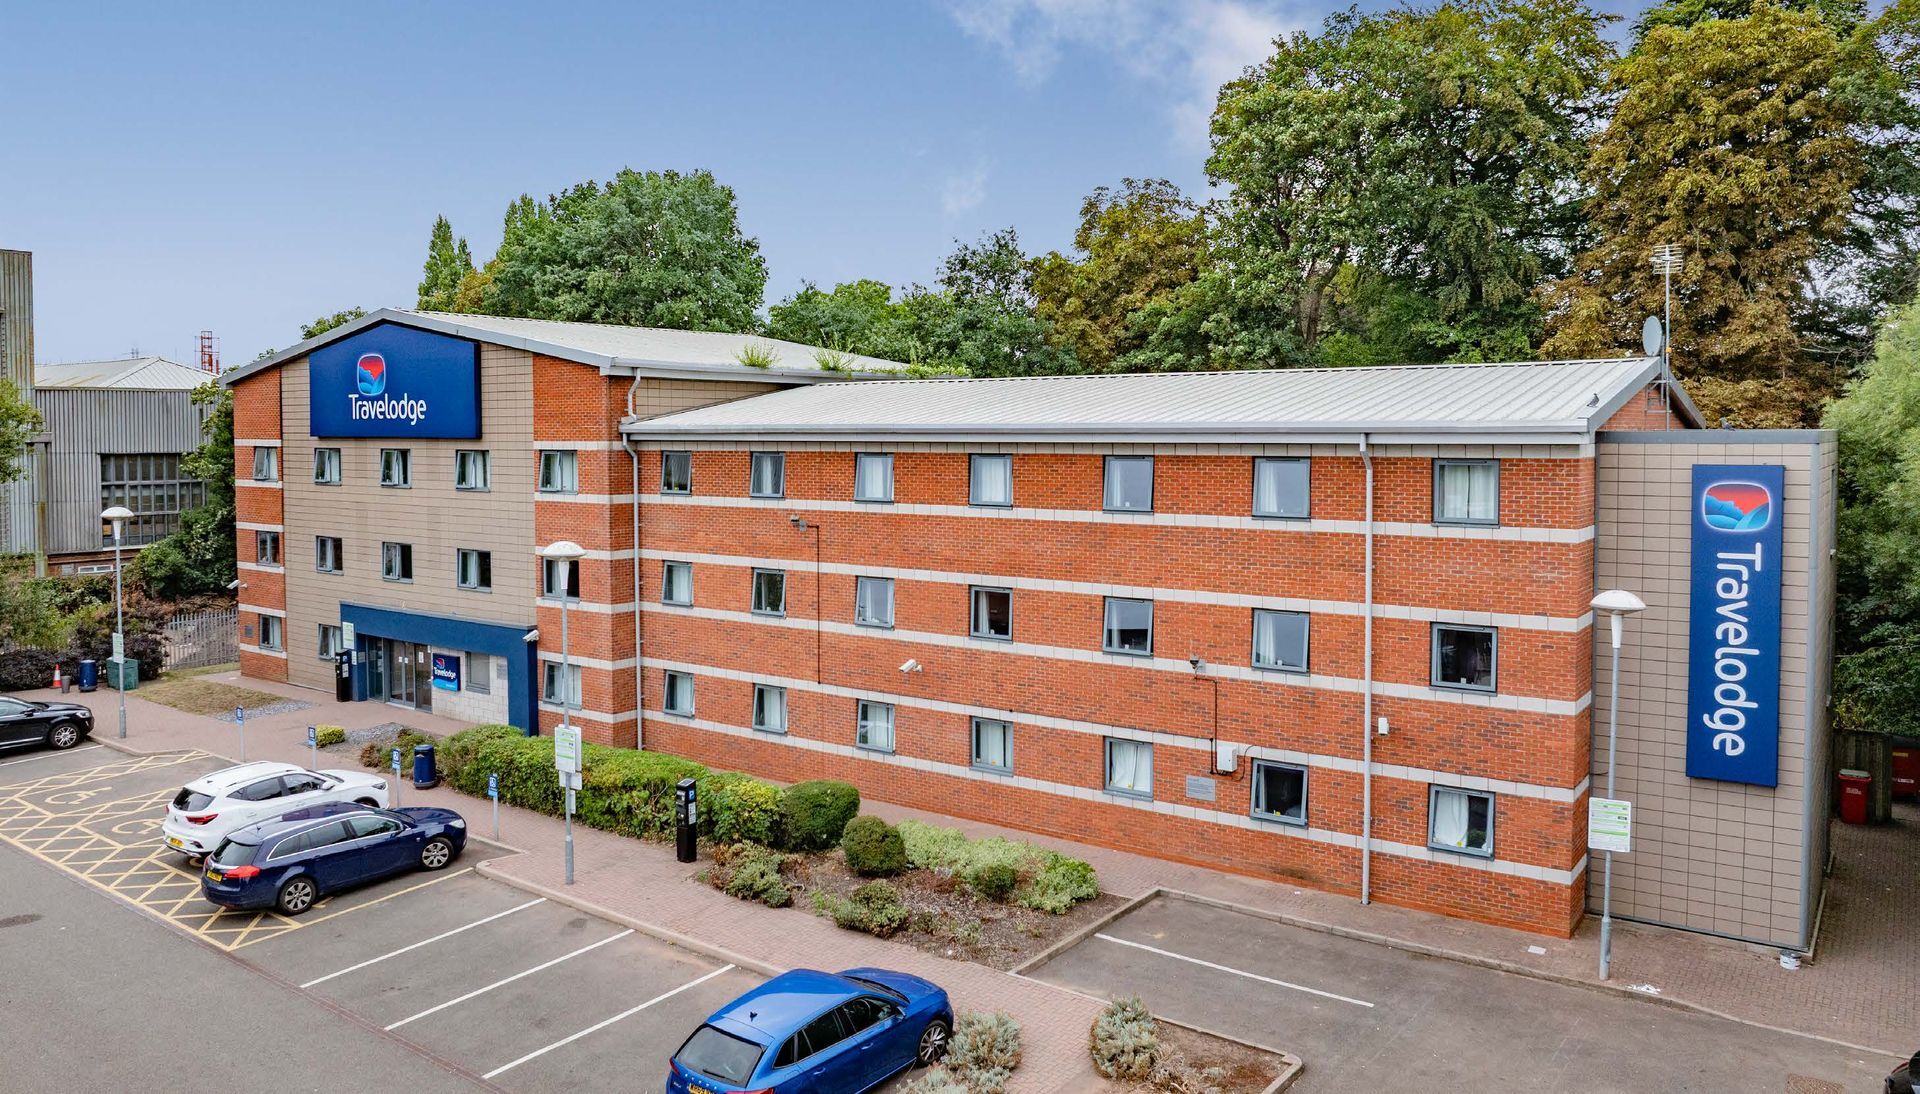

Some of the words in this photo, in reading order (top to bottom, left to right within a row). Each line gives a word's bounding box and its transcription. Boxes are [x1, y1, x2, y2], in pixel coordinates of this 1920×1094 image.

[349, 393, 426, 425] Travelodge
[1703, 542, 1762, 756] Travelodge
[434, 667, 456, 680] Travelodge
[689, 790, 695, 800] P
